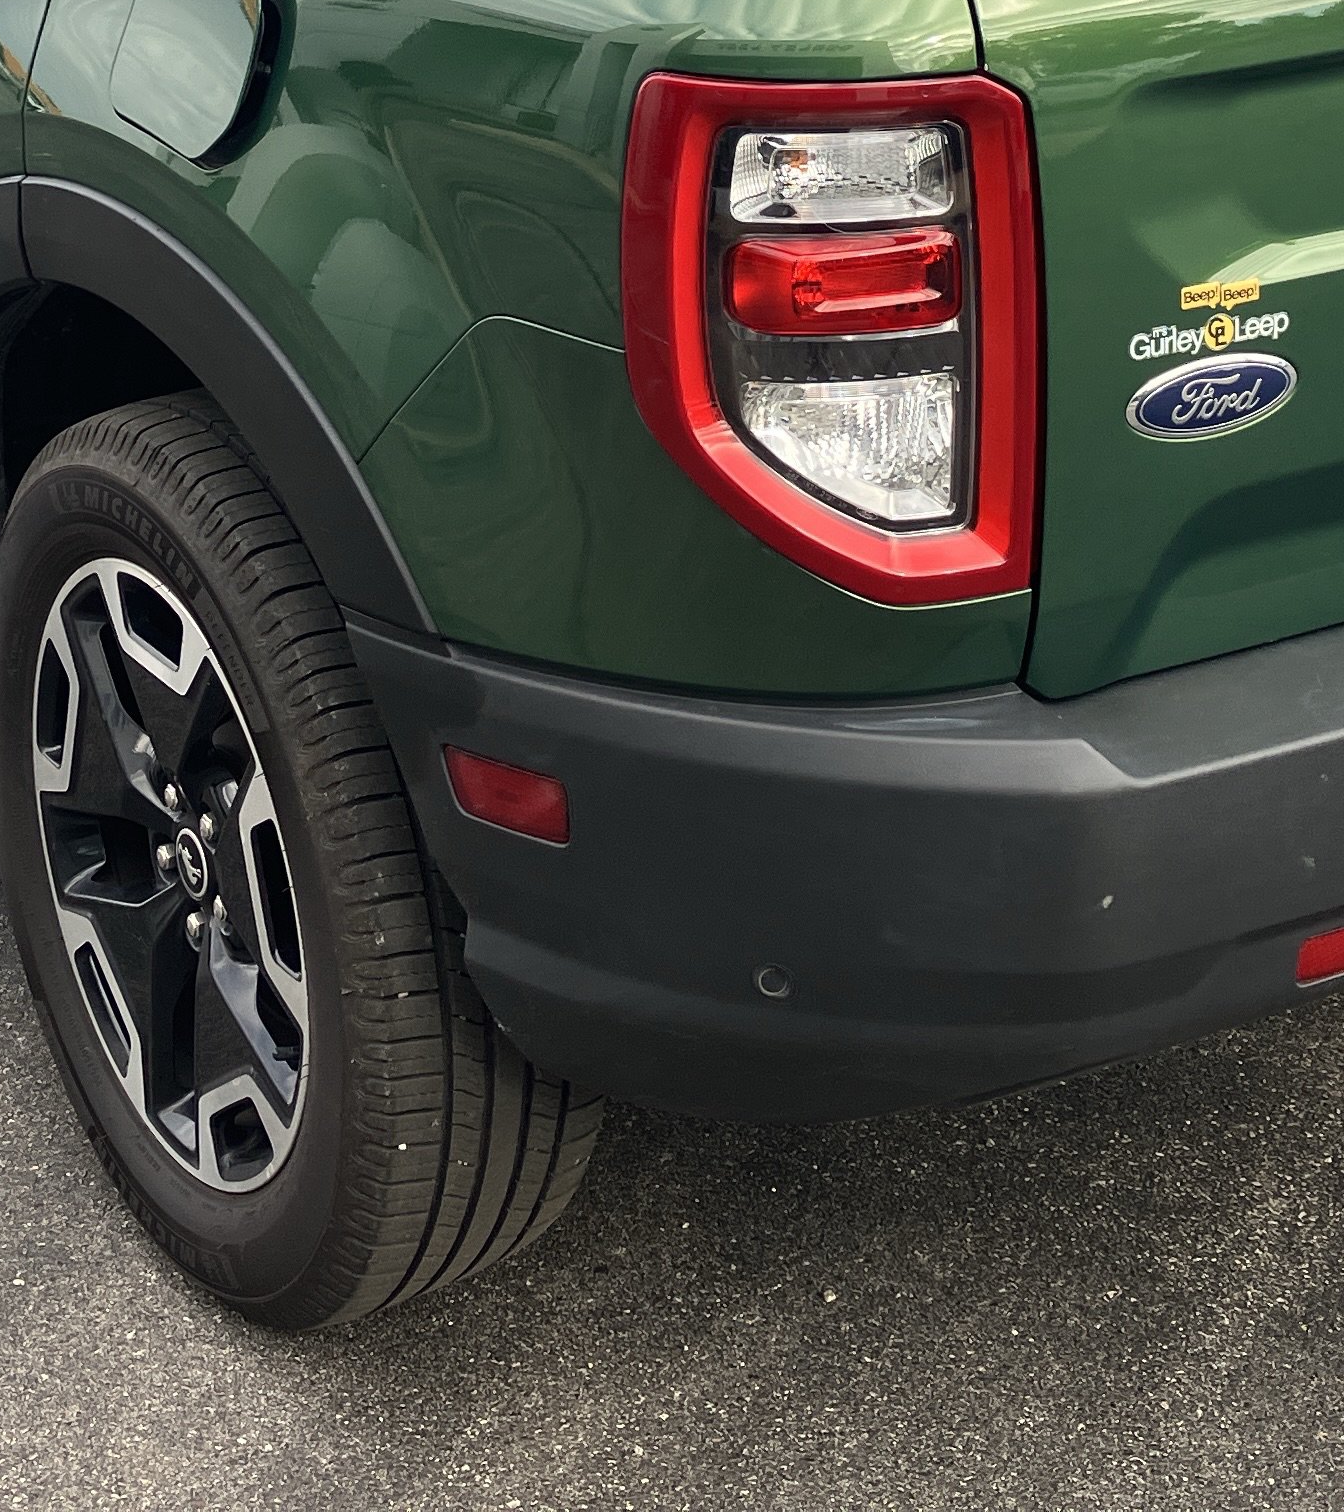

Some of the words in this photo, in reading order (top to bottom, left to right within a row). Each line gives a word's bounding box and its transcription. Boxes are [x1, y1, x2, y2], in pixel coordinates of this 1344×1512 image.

[1184, 286, 1220, 304] Beep!
[1223, 284, 1258, 302] Beep!
[1130, 326, 1205, 360] Gurley
[1235, 313, 1287, 342] Leep
[1171, 373, 1263, 425] Ford
[83, 483, 200, 594] MICHELIN
